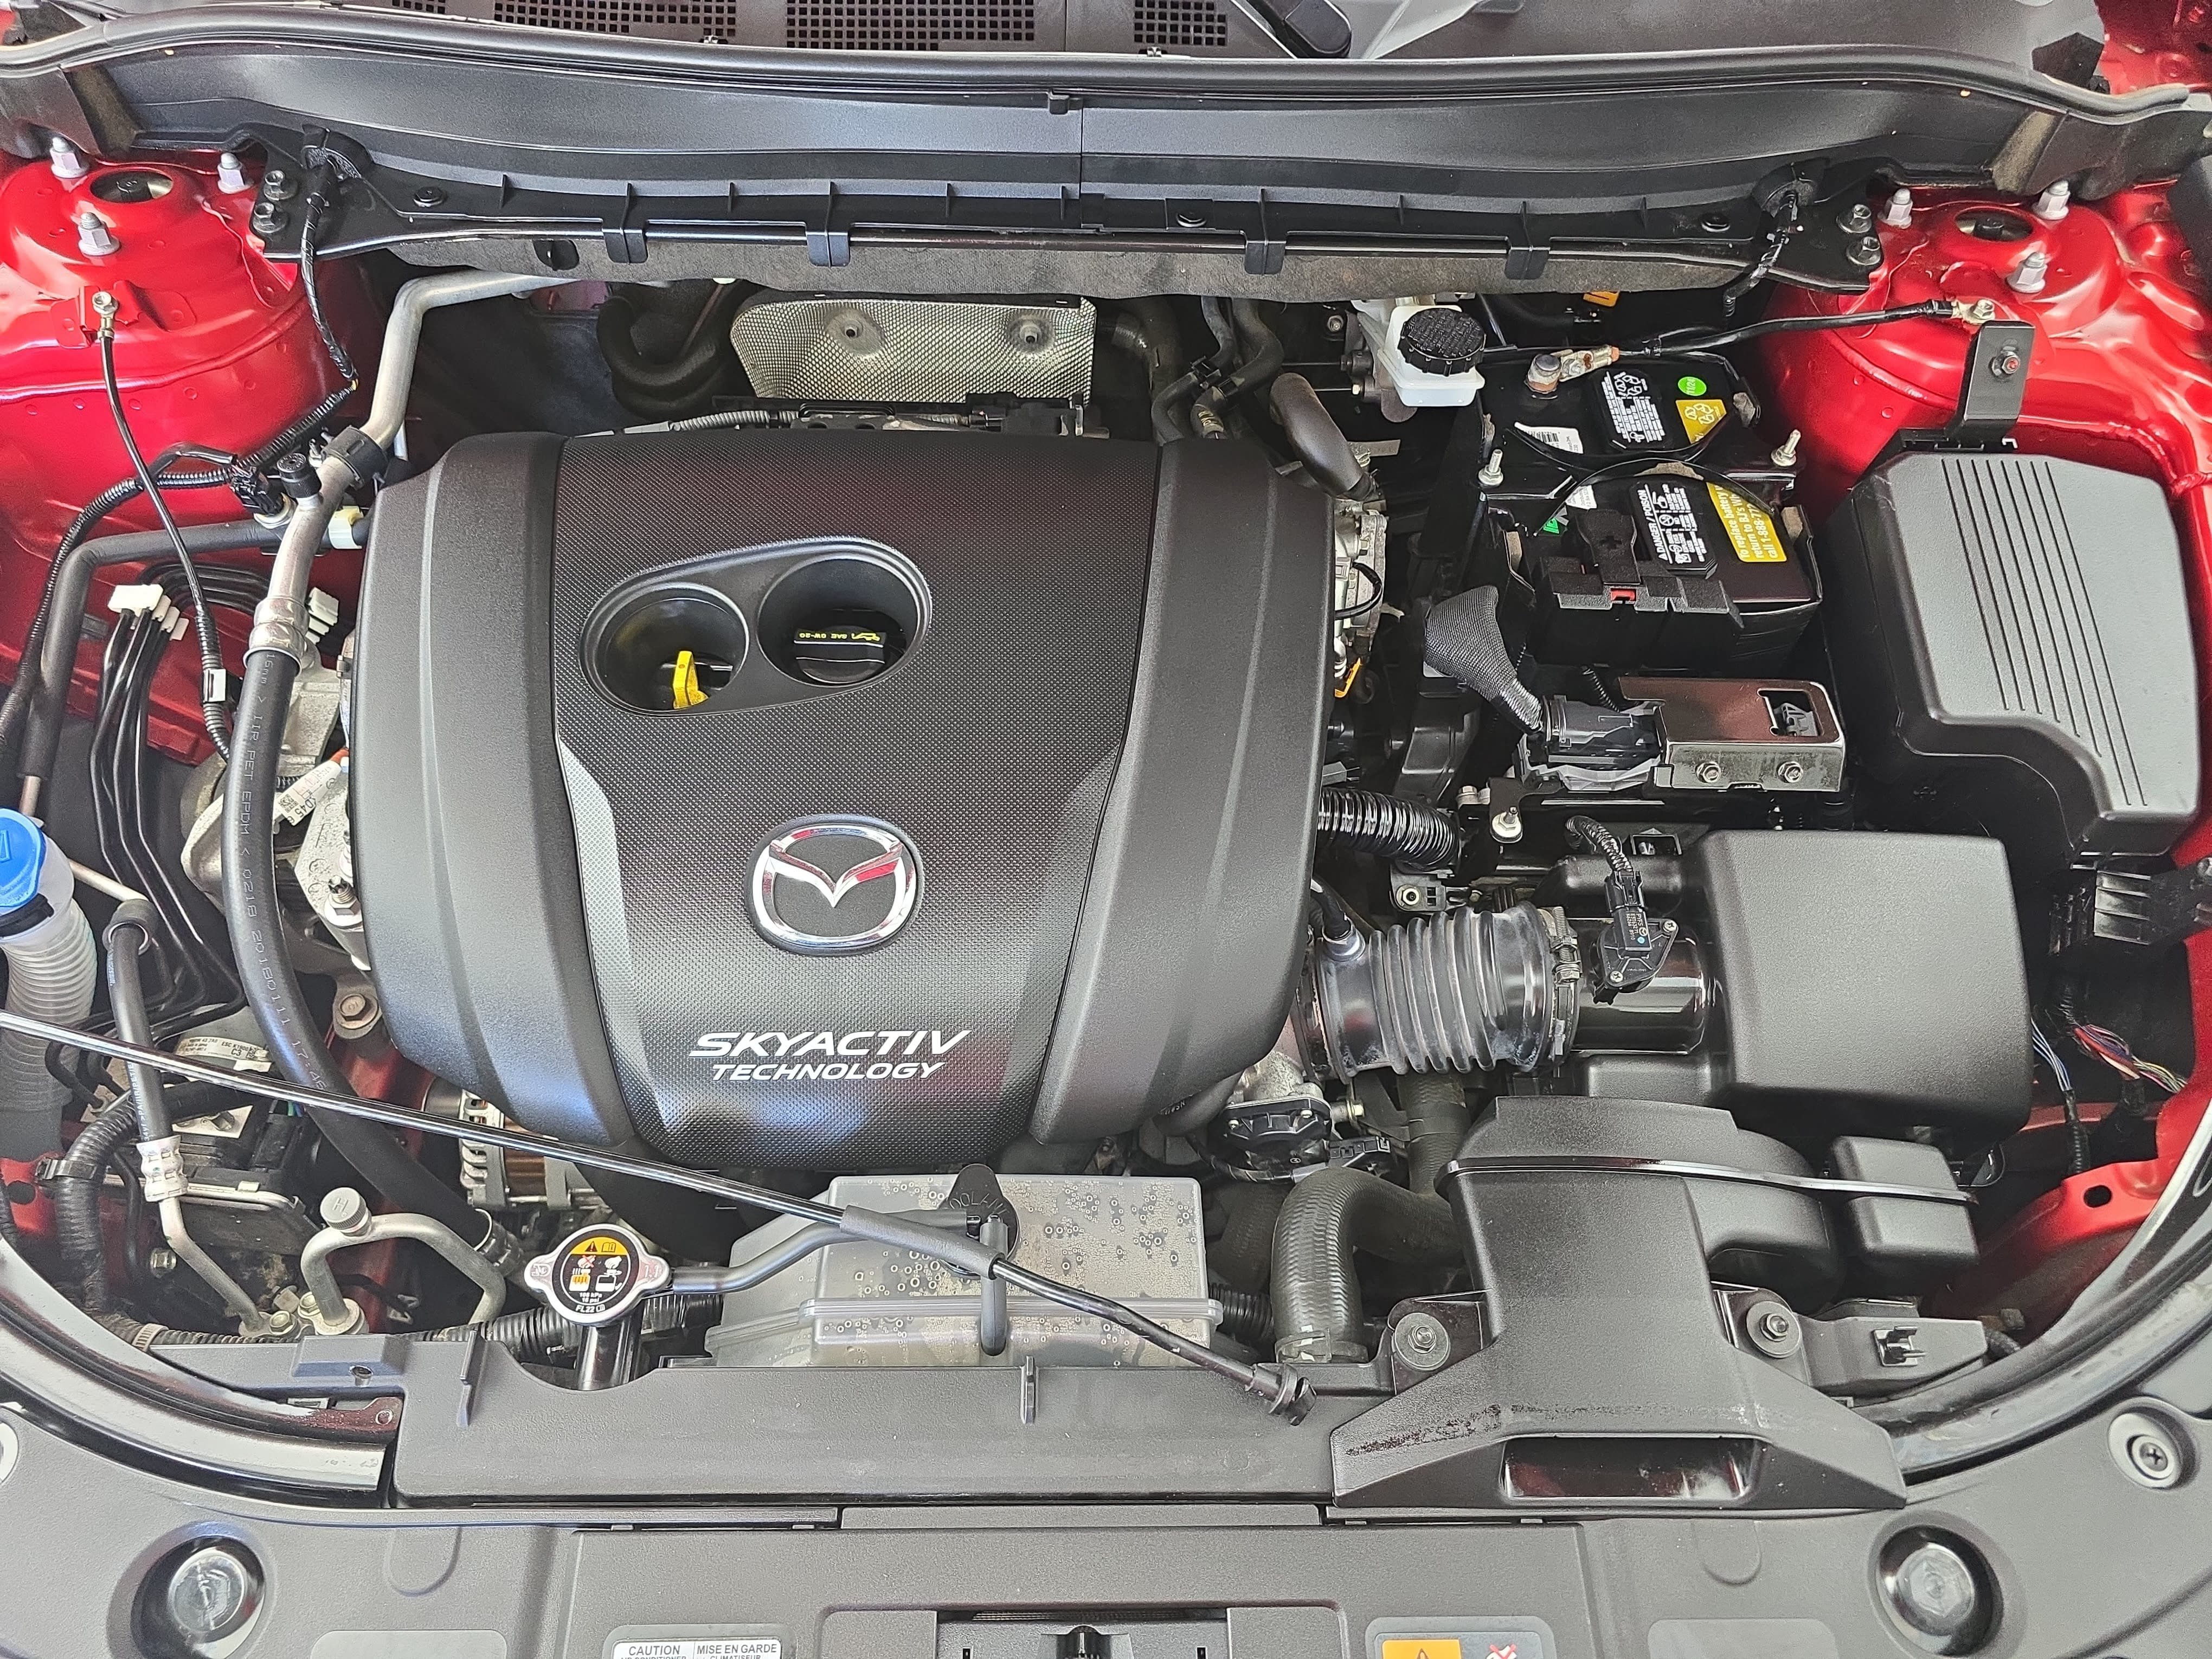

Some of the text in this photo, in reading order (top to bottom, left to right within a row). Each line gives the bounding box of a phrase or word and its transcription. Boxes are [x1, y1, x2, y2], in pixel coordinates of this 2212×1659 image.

[1637, 490, 1653, 516] POISON
[1716, 492, 1734, 518] battery
[1735, 507, 1748, 523] BJ's
[1649, 522, 1666, 552] DANGER
[1728, 520, 1746, 548] replace
[1744, 524, 1753, 532] to
[1739, 549, 1750, 558] To
[1747, 533, 1764, 558] return
[1761, 544, 1778, 558] call
[260, 653, 275, 684] 16mm
[243, 750, 256, 781] PET
[240, 791, 252, 835] EPDM
[689, 1030, 972, 1057] SKYACTIV
[712, 1062, 945, 1081] TECHNOLOGY
[944, 1191, 1010, 1215] OOLANT
[575, 1304, 595, 1313] FL22
[628, 1645, 680, 1656] CAUTION
[697, 1644, 777, 1655] MISE EN GARDE
